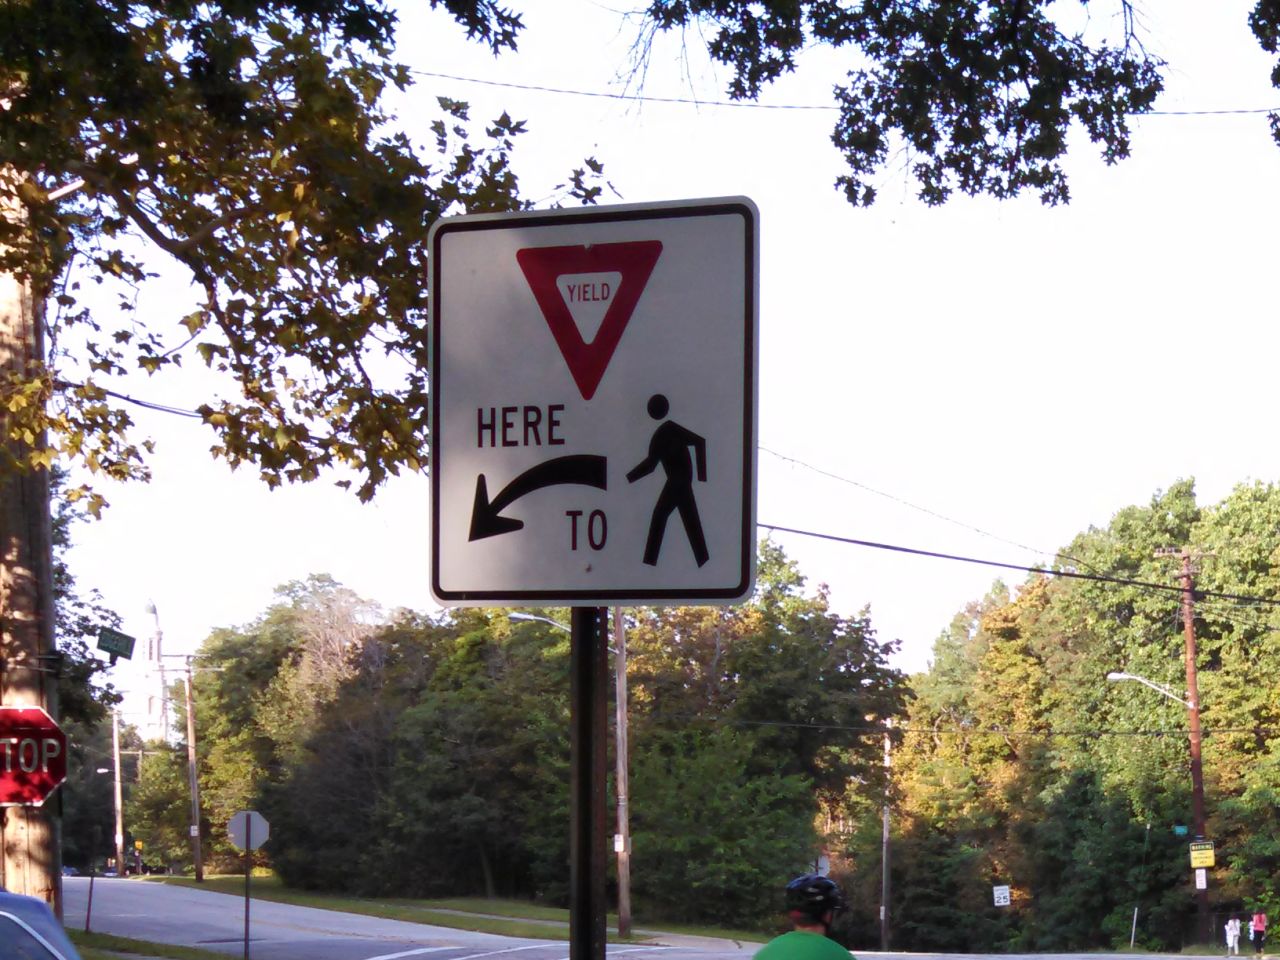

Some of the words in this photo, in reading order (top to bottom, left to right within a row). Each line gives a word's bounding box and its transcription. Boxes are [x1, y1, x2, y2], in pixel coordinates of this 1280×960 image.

[566, 282, 611, 302] YIELD
[476, 404, 566, 448] HERE
[565, 509, 609, 551] TO
[0, 738, 61, 773] TOP
[995, 895, 1009, 904] 25
